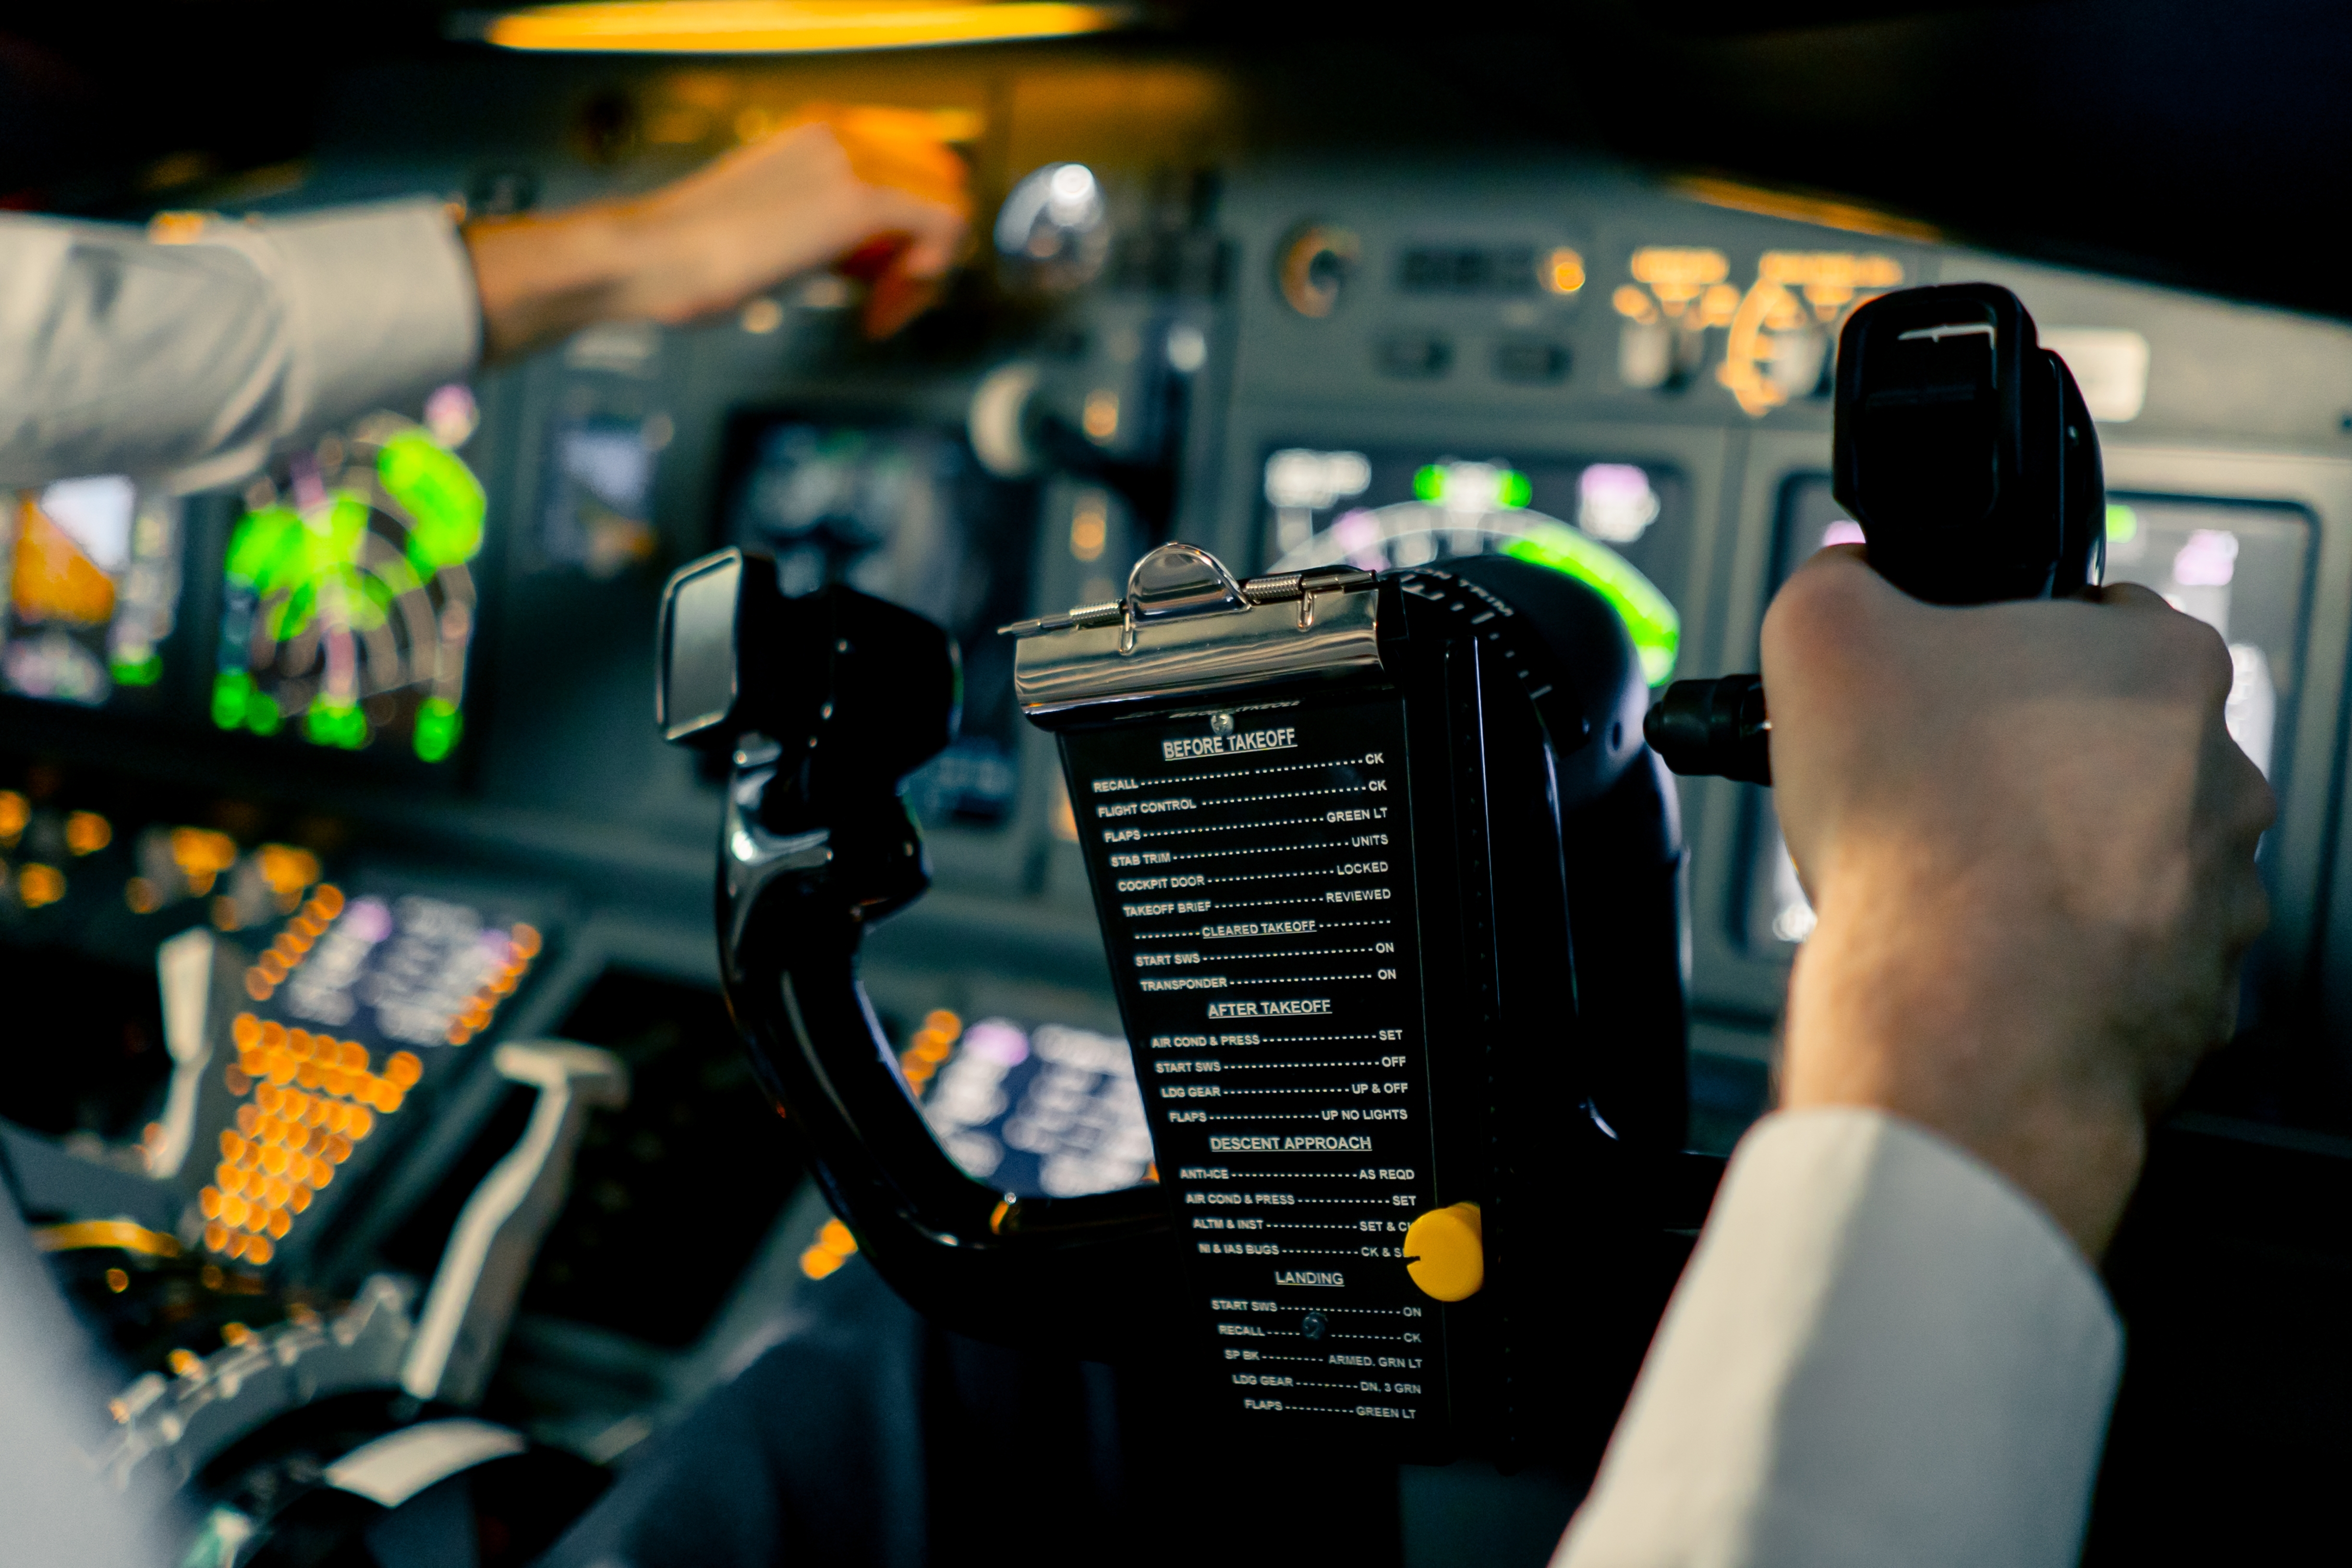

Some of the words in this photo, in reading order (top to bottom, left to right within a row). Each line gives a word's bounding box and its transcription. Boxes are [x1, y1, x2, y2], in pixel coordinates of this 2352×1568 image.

[1163, 736, 1224, 759] BEFORE
[1226, 728, 1296, 751] TAKEOFF
[1093, 779, 1139, 792] RECALL
[1365, 753, 1384, 764] CK
[1098, 803, 1137, 817] FLIGHT
[1140, 799, 1196, 813] CONTROL
[1369, 780, 1387, 791] CK
[1104, 829, 1140, 842] FLAPS
[1327, 809, 1370, 823] GREEN
[1374, 807, 1387, 818] LT
[1111, 854, 1140, 867] STAB
[1142, 852, 1170, 864] TRIM
[1352, 834, 1388, 847] UNITS
[1118, 878, 1168, 891] COCKPIT
[1171, 875, 1205, 887] DOOR
[1337, 862, 1388, 875] LOCKED
[1123, 903, 1174, 917] TAKEOFF
[1177, 901, 1211, 913] BRIEF
[1326, 889, 1391, 902] REVIEWED
[1202, 924, 1258, 937] CLEARED
[1261, 921, 1316, 935] TAKEOFF
[1136, 954, 1171, 966] START
[1174, 953, 1200, 964] SWS
[1376, 943, 1394, 953] ON
[1140, 977, 1227, 991] TRANSPONDER
[1378, 969, 1396, 980] ON
[1208, 1004, 1258, 1017] AFTER
[1261, 999, 1331, 1014] TAKEOFF
[1152, 1037, 1172, 1048] AIR
[1174, 1036, 1207, 1047] COND
[1210, 1036, 1218, 1046] &
[1221, 1034, 1260, 1045] PRESS
[1379, 1030, 1402, 1041] SET
[1156, 1062, 1192, 1073] START
[1195, 1061, 1221, 1072] SWS
[1382, 1056, 1406, 1067] OFF
[1162, 1087, 1185, 1097] LDG
[1188, 1086, 1221, 1097] GEAR
[1352, 1084, 1368, 1094] UP
[1372, 1084, 1381, 1093] &
[1384, 1083, 1407, 1094] OFF
[1169, 1112, 1207, 1122] FLAPS
[1321, 1110, 1338, 1120] UP
[1342, 1110, 1359, 1120] NO
[1363, 1109, 1407, 1119] LIGHTS
[1211, 1137, 1280, 1149] DESCENT
[1285, 1137, 1371, 1149] APPROACH
[1181, 1169, 1229, 1179] ANTI-ICE
[1359, 1169, 1376, 1179] AS
[1379, 1169, 1414, 1180] REQD
[1187, 1194, 1206, 1203] AIR
[1208, 1194, 1241, 1204] COND
[1245, 1195, 1253, 1204] &
[1256, 1194, 1295, 1204] PRESS
[1393, 1195, 1416, 1205] SET
[1193, 1219, 1224, 1228] ALTM
[1226, 1220, 1235, 1228] &
[1237, 1220, 1263, 1229] INST
[1359, 1221, 1382, 1231] SET
[1387, 1222, 1395, 1232] &
[1213, 1244, 1221, 1253] &
[1224, 1244, 1243, 1254] IAS
[1246, 1244, 1279, 1254] BUGS
[1361, 1247, 1379, 1257] CK
[1382, 1248, 1391, 1257] &
[1275, 1272, 1344, 1285] LANDING
[1212, 1300, 1248, 1310] START
[1251, 1301, 1277, 1312] SWS
[1404, 1307, 1421, 1316] ON
[1219, 1325, 1265, 1336] RECALL
[1404, 1333, 1420, 1342] CK
[1225, 1350, 1240, 1359] SP
[1243, 1351, 1260, 1360] BK
[1379, 1357, 1405, 1367] GRN
[1409, 1359, 1422, 1368] LT
[1233, 1375, 1257, 1385] LDG
[1261, 1376, 1293, 1386] GEAR
[1385, 1383, 1391, 1392] 3
[1394, 1384, 1420, 1394] GRN
[1245, 1399, 1282, 1410] FLAPS
[1357, 1407, 1399, 1417] GREEN
[1403, 1410, 1416, 1419] LT
